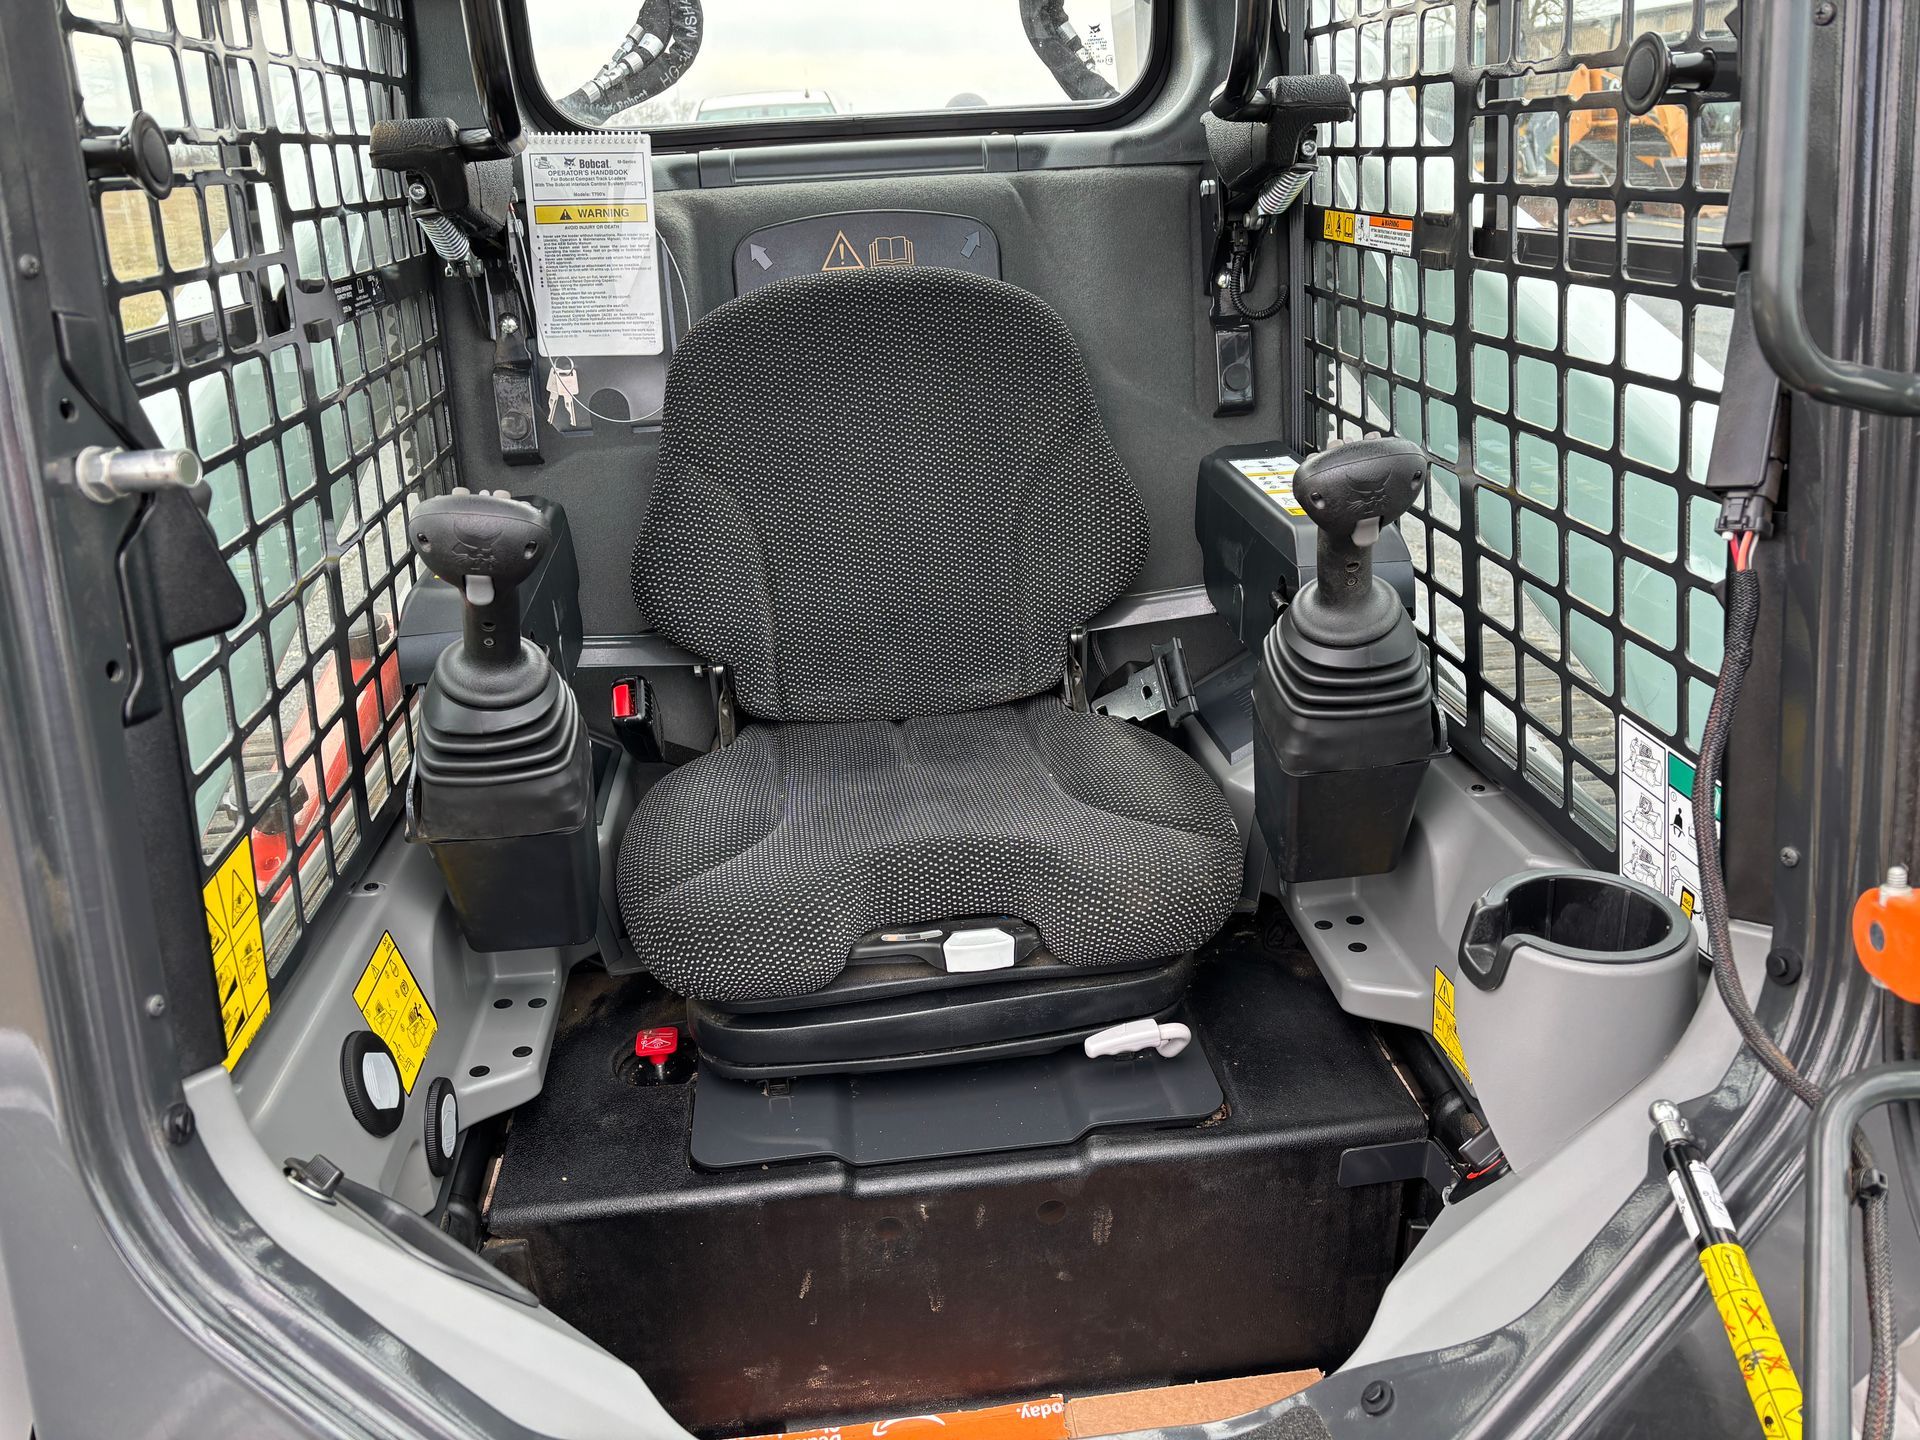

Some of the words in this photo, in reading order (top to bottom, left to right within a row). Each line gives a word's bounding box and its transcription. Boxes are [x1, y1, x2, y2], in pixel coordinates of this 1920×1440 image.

[579, 159, 609, 169] Bobcat
[547, 169, 589, 177] OPERATOR'S
[577, 208, 630, 218] WARNING
[1384, 220, 1400, 228] WARNING
[1016, 1402, 1064, 1420] oday.
